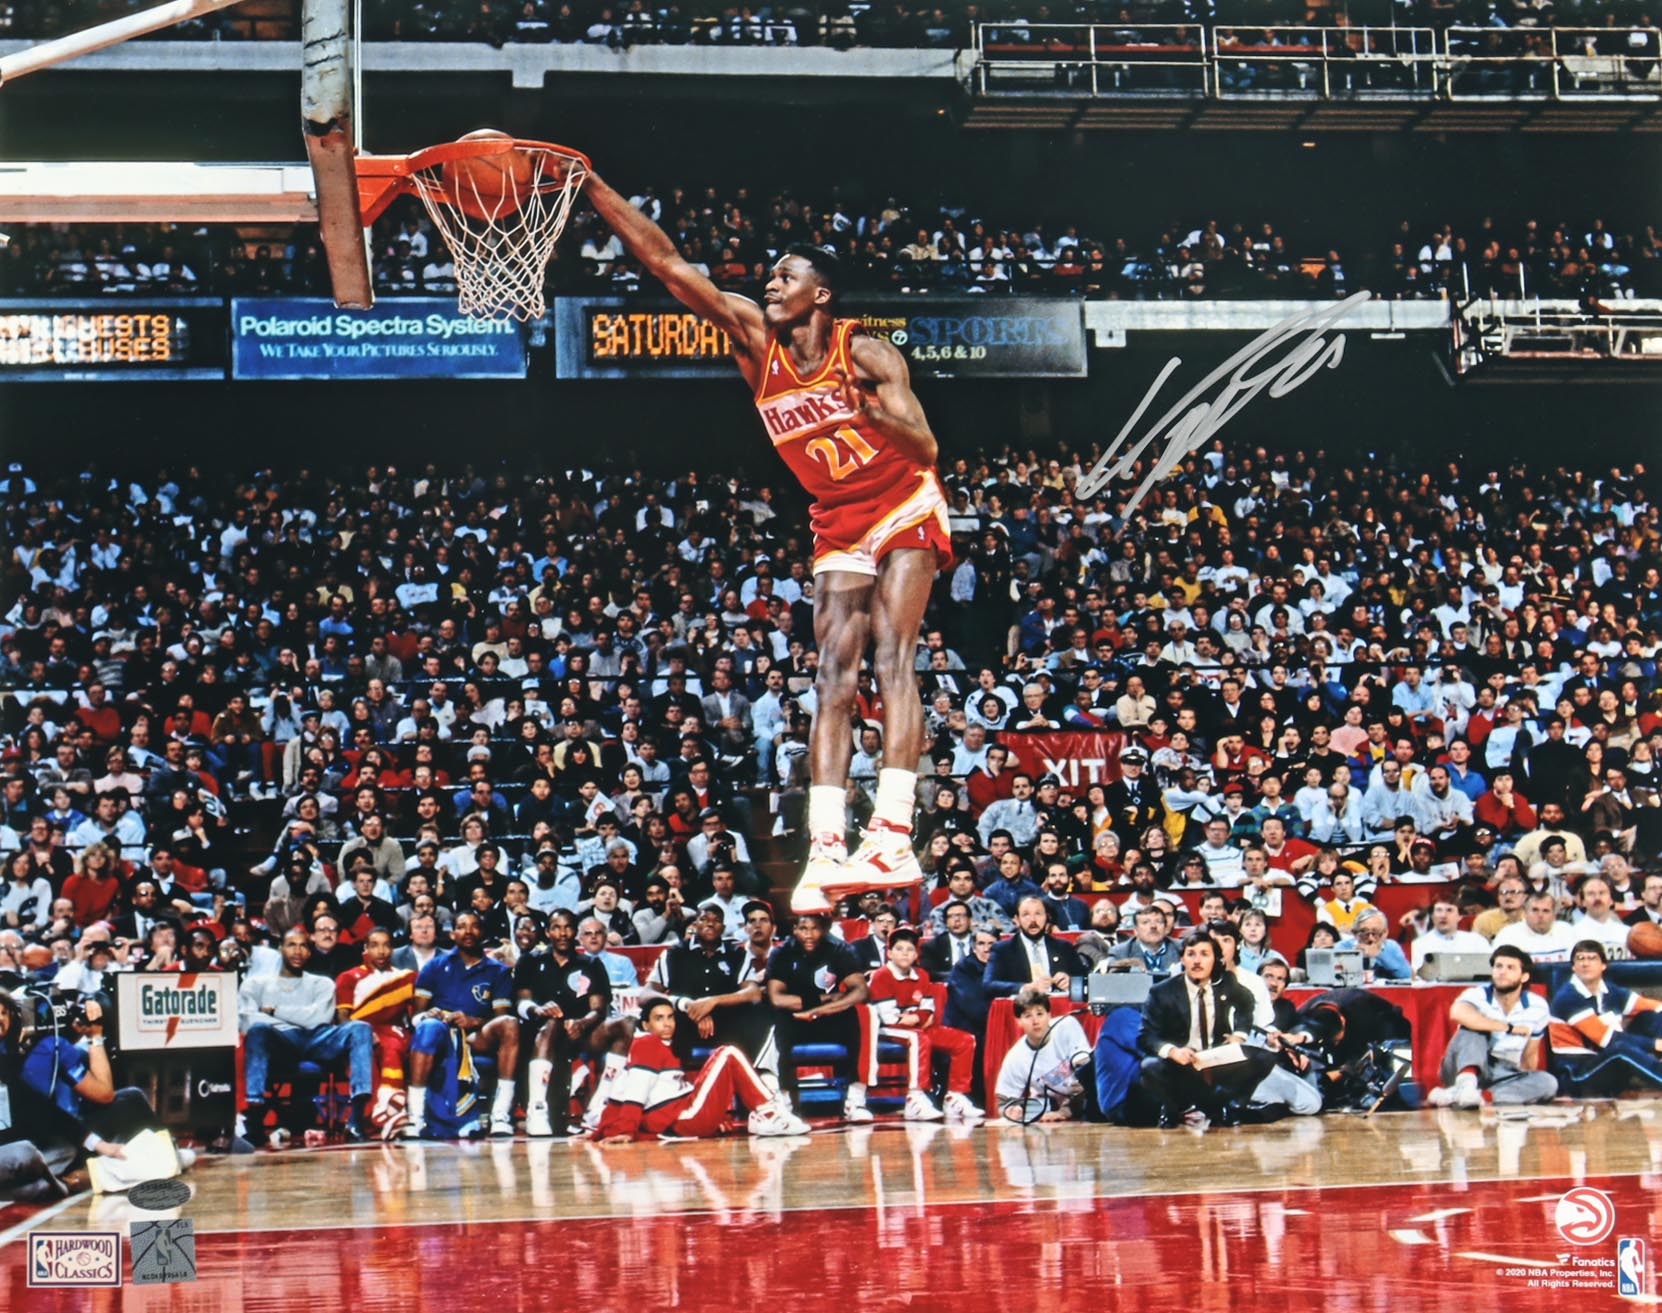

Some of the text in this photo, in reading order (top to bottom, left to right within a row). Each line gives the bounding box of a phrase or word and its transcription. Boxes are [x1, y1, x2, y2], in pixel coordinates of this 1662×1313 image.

[240, 316, 332, 336] Polaroid
[335, 315, 424, 339] Spectra
[862, 313, 907, 328] itness
[910, 316, 1068, 345] SPORTS
[259, 343, 284, 358] WE
[287, 343, 320, 358] TAKE
[322, 342, 360, 358] YOUR
[361, 342, 424, 358] PICTURES
[954, 346, 968, 359] &
[970, 346, 987, 359] 10
[805, 425, 880, 481] 21
[1043, 758, 1106, 787] XIT
[142, 984, 217, 1016] Gatorade
